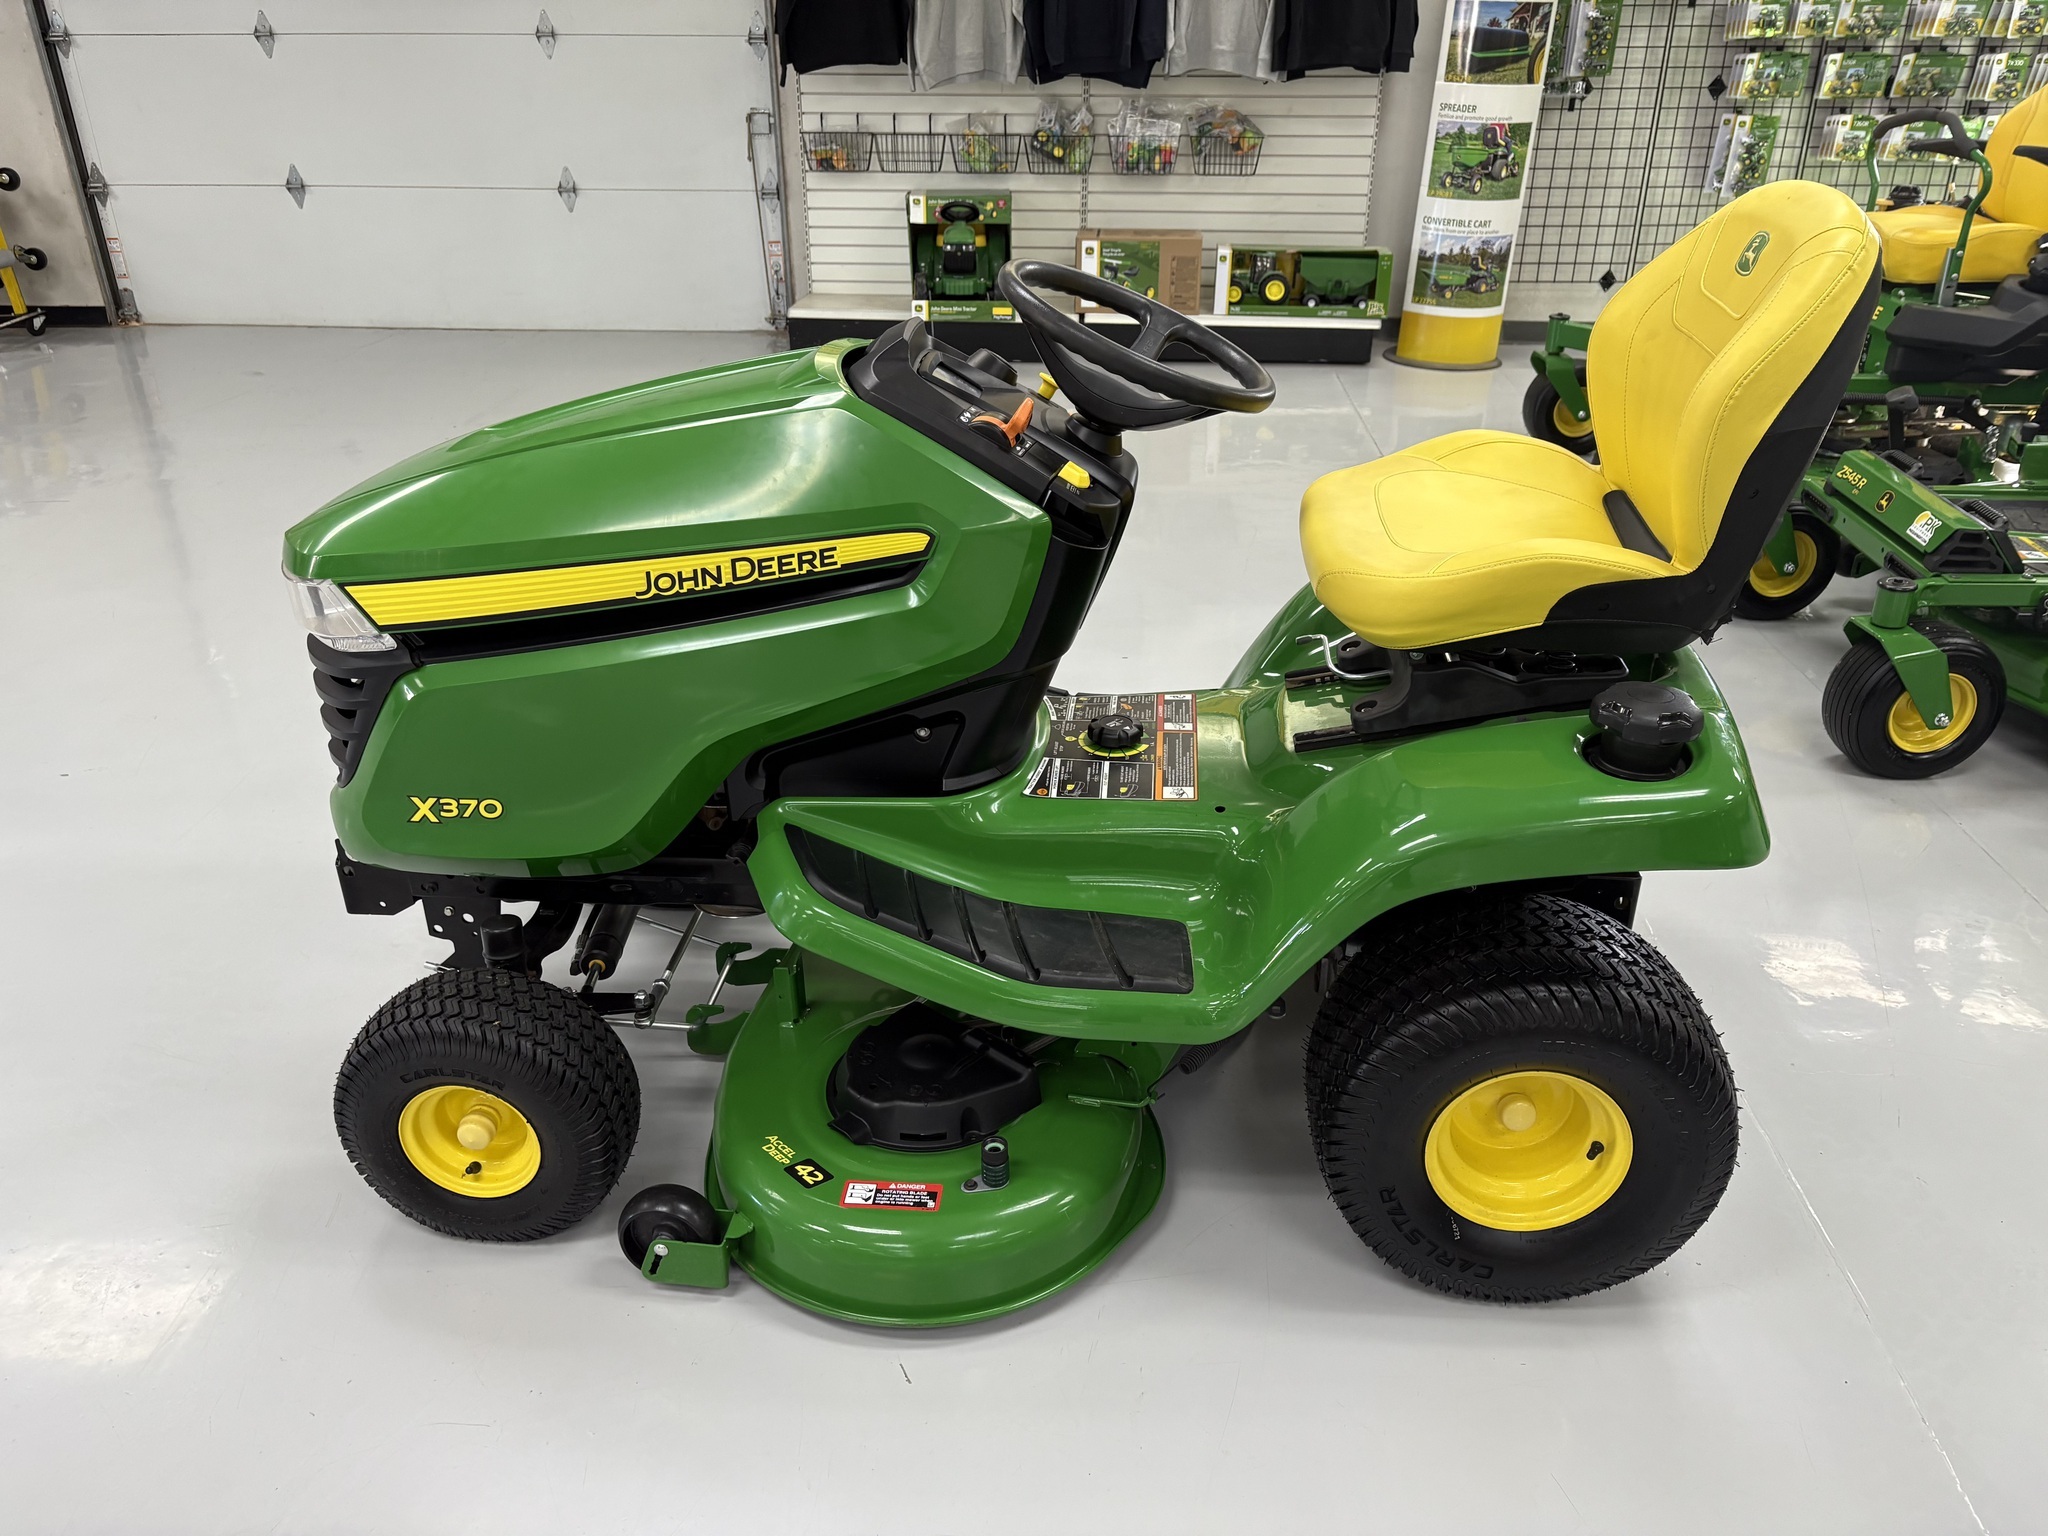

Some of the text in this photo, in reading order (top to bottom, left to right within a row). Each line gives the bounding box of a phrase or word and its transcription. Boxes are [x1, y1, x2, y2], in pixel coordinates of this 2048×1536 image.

[1439, 102, 1477, 113] SPREADER
[1422, 215, 1492, 228] CONVERTIBLE CART
[1921, 516, 1940, 535] PK
[635, 546, 838, 598] JOHN DEERE
[407, 795, 504, 824] X370
[399, 1067, 506, 1091] CARLSTAR
[761, 1143, 791, 1164] DEEP
[764, 1135, 796, 1159] ACCEL
[794, 1164, 824, 1185] 42
[1378, 1184, 1495, 1281] CARLSTAR
